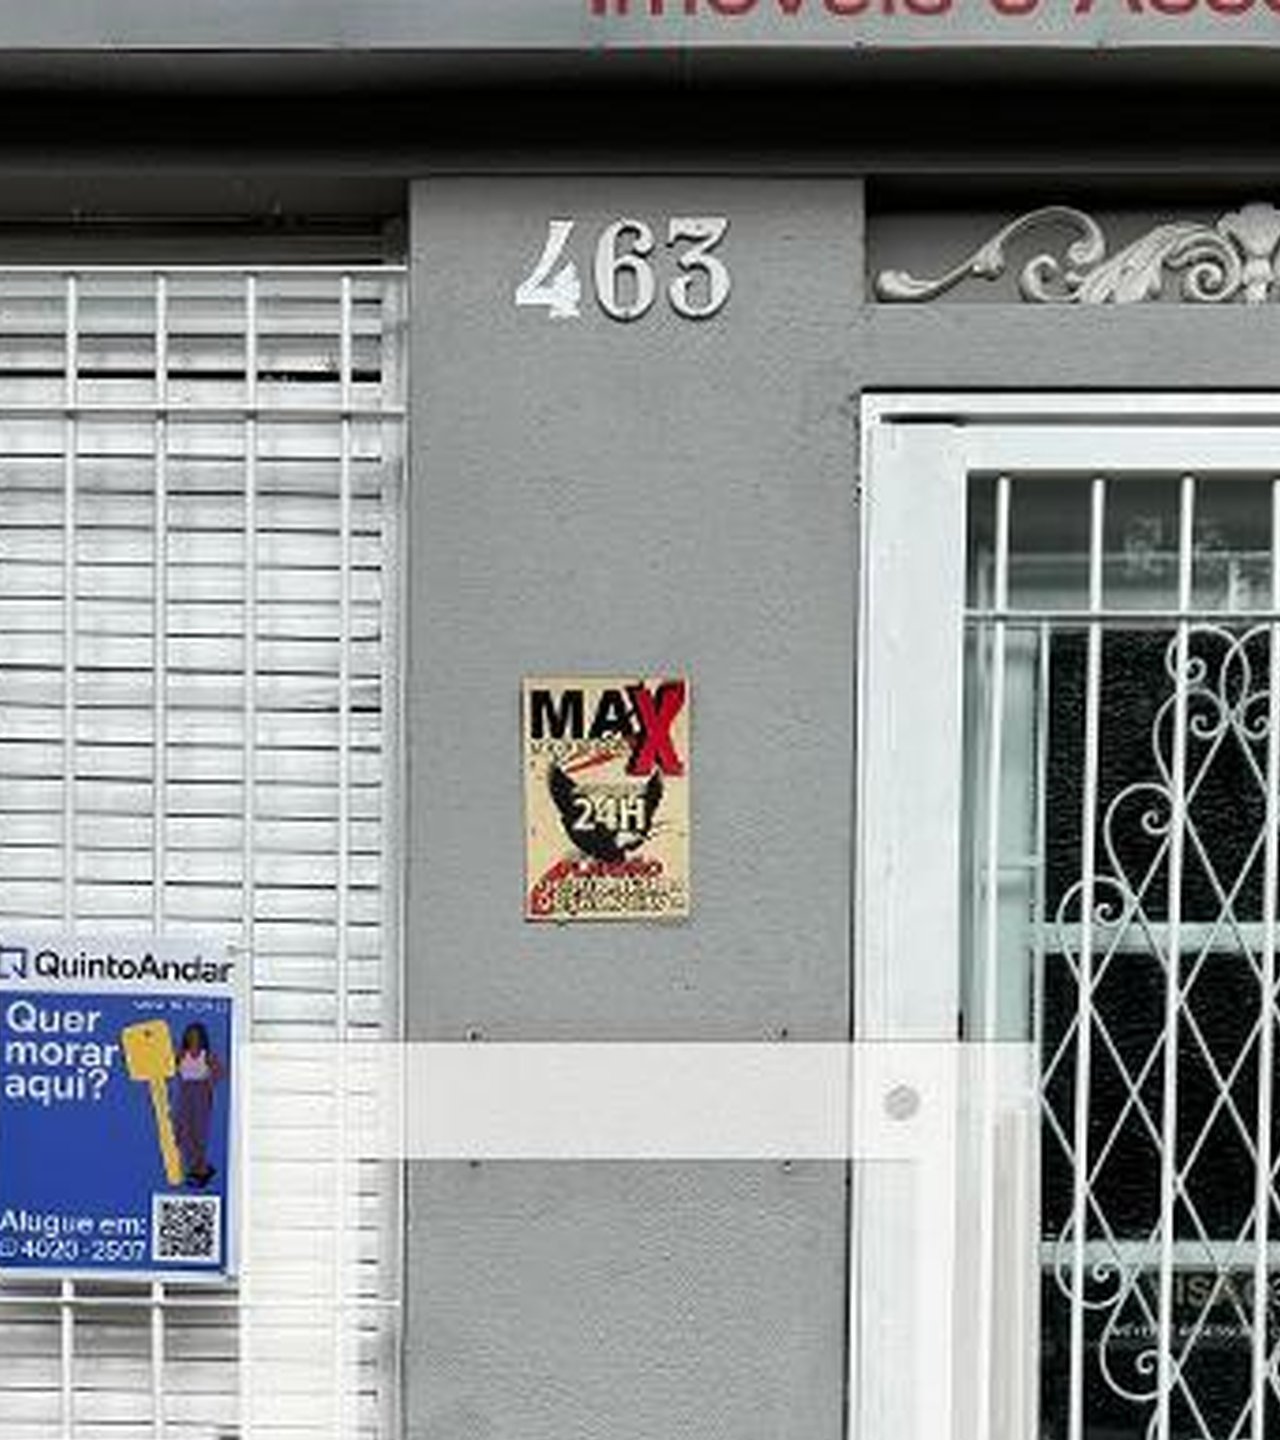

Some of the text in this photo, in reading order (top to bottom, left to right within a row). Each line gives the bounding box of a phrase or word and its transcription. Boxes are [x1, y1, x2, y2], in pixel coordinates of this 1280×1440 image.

[515, 216, 732, 322] 463
[530, 679, 687, 778] MAX
[572, 796, 646, 831] 24H
[34, 949, 234, 984] QuintoAndar
[5, 999, 101, 1034] Quer
[4, 1039, 120, 1067] morar
[4, 1067, 109, 1106] aqui?
[99, 1217, 147, 1236] em:
